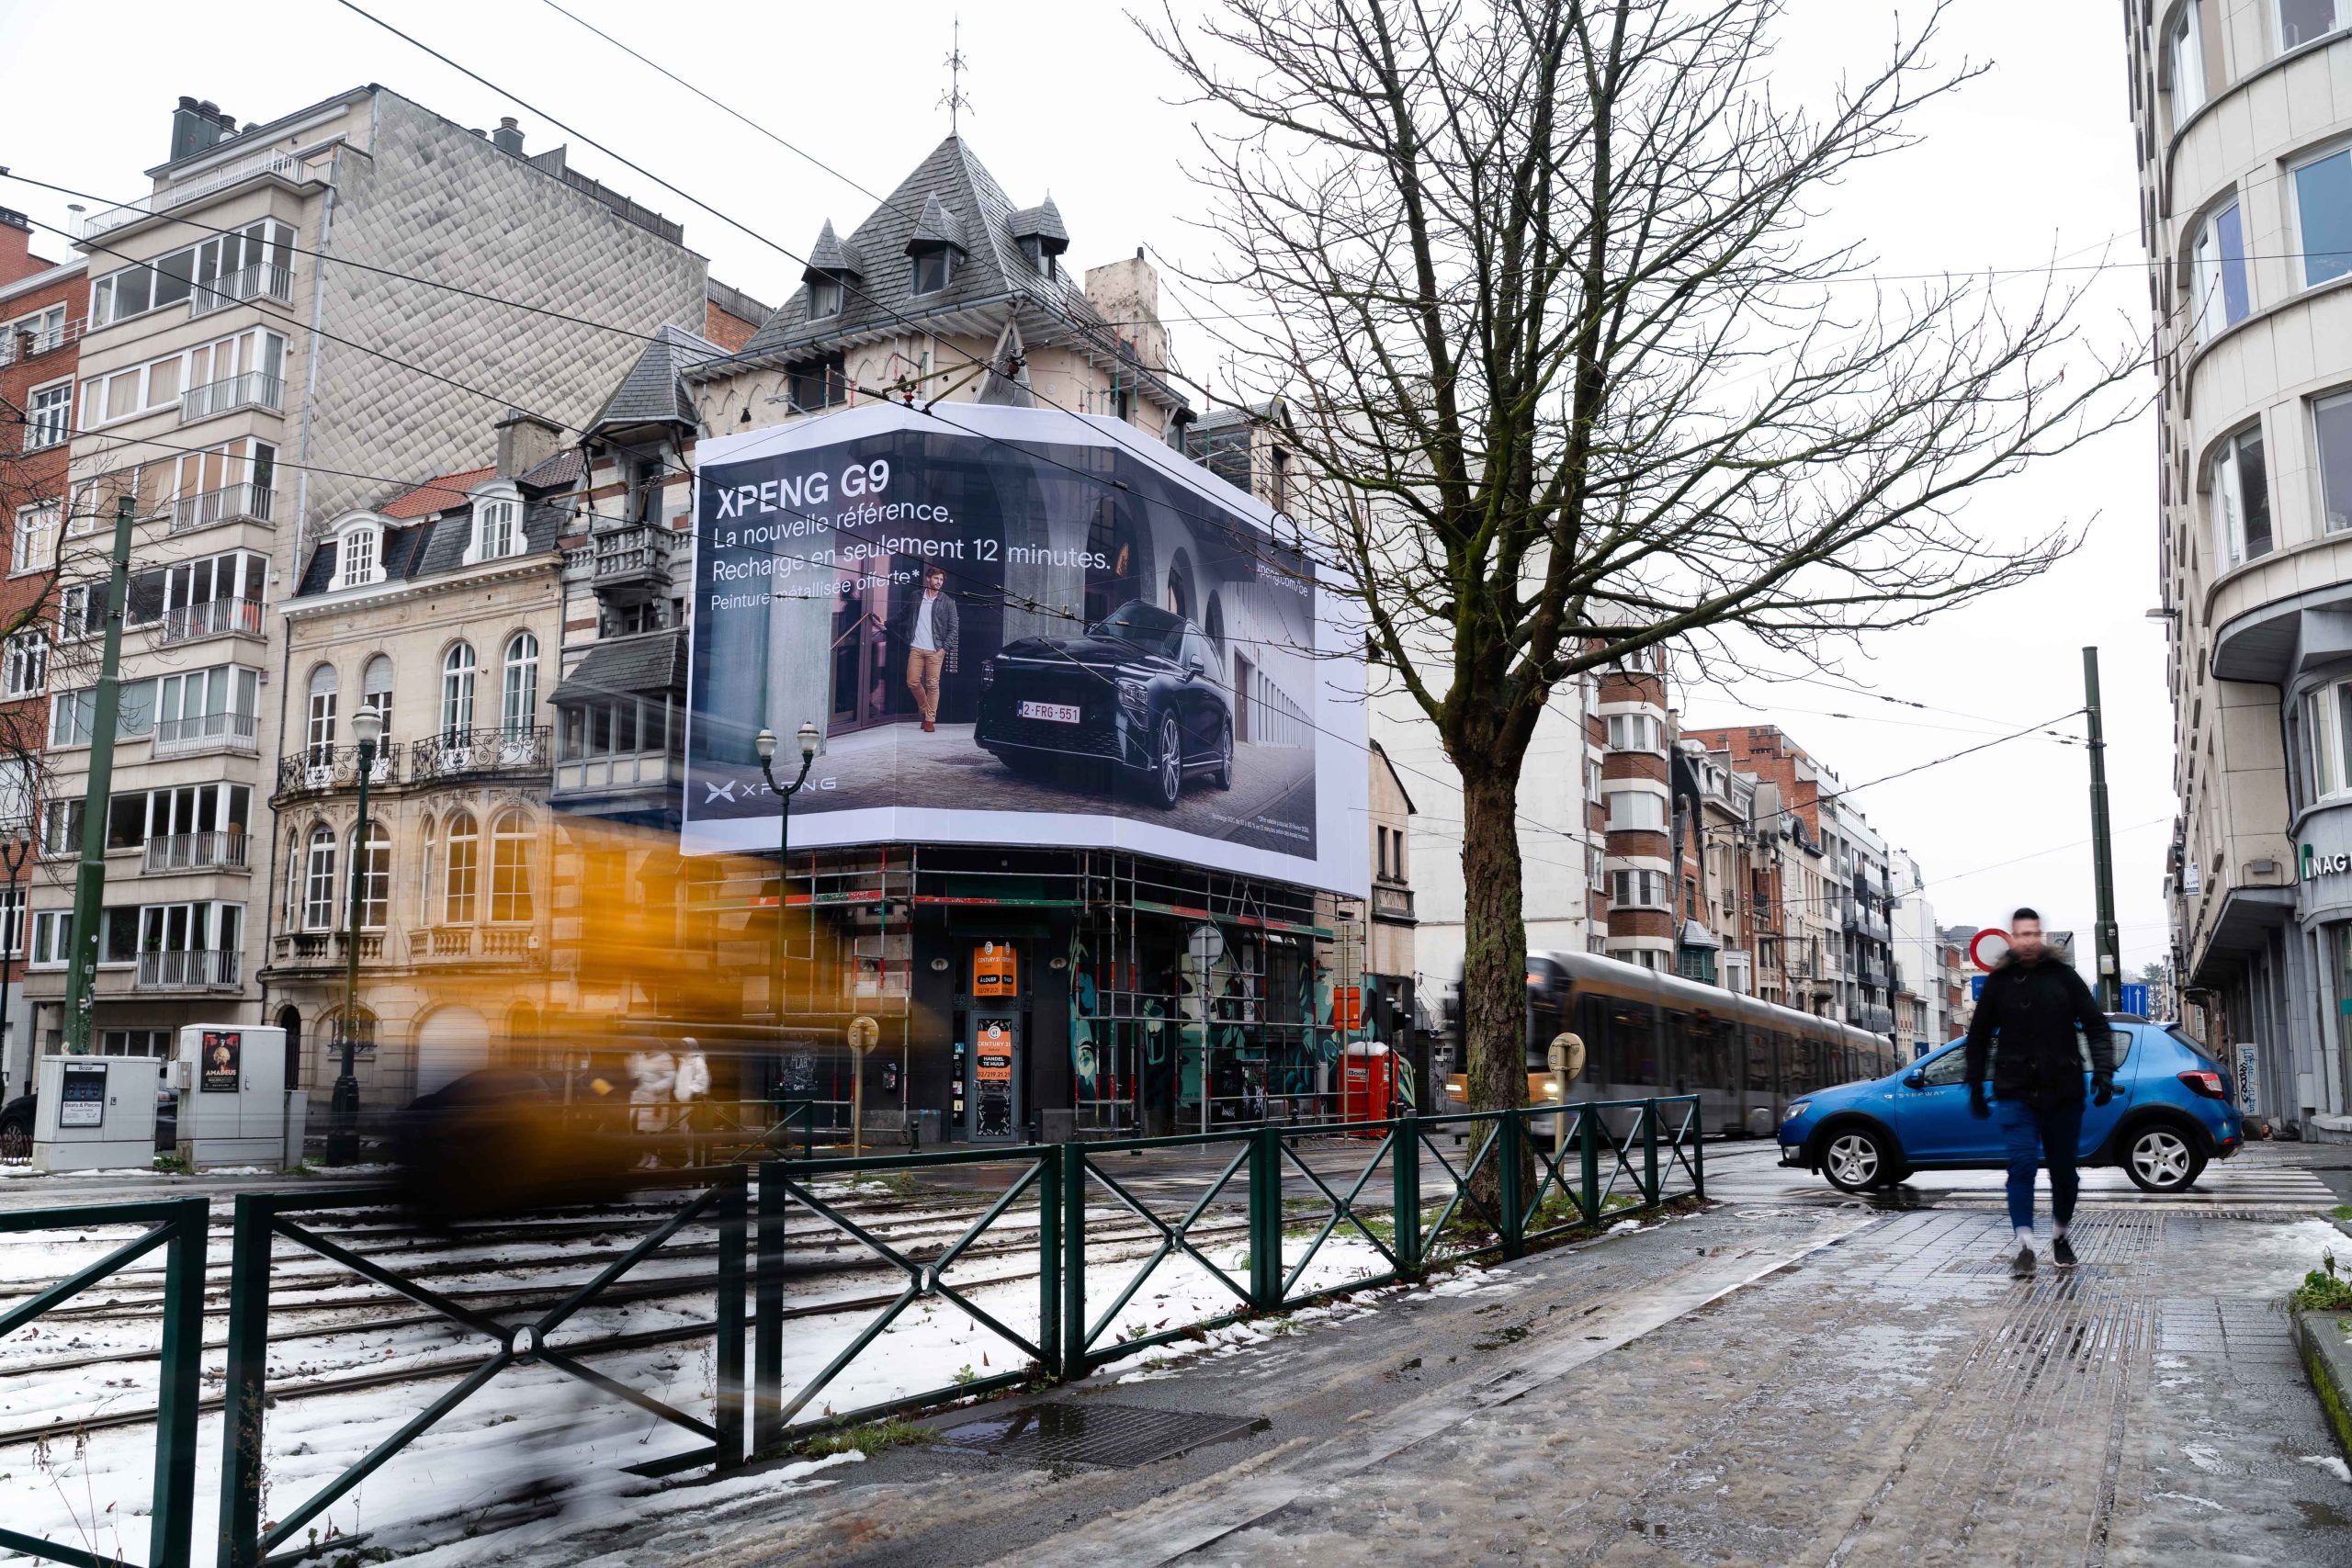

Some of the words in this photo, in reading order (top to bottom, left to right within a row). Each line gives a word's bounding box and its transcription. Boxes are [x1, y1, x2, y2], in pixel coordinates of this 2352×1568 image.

[716, 471, 829, 519] XPENG
[841, 459, 890, 497] G9
[714, 528, 736, 549] La
[743, 513, 829, 545] nouvelle
[836, 502, 954, 529] référence.
[713, 554, 805, 582] Recharge
[810, 548, 836, 566] en
[843, 535, 965, 562] seulement
[973, 538, 999, 562] 12
[1008, 543, 1111, 570] minutes.
[711, 593, 770, 611] Peinture
[775, 579, 852, 603] métallisée
[2312, 852, 2352, 876] NAG
[1897, 1090, 1946, 1099] STEPWAY
